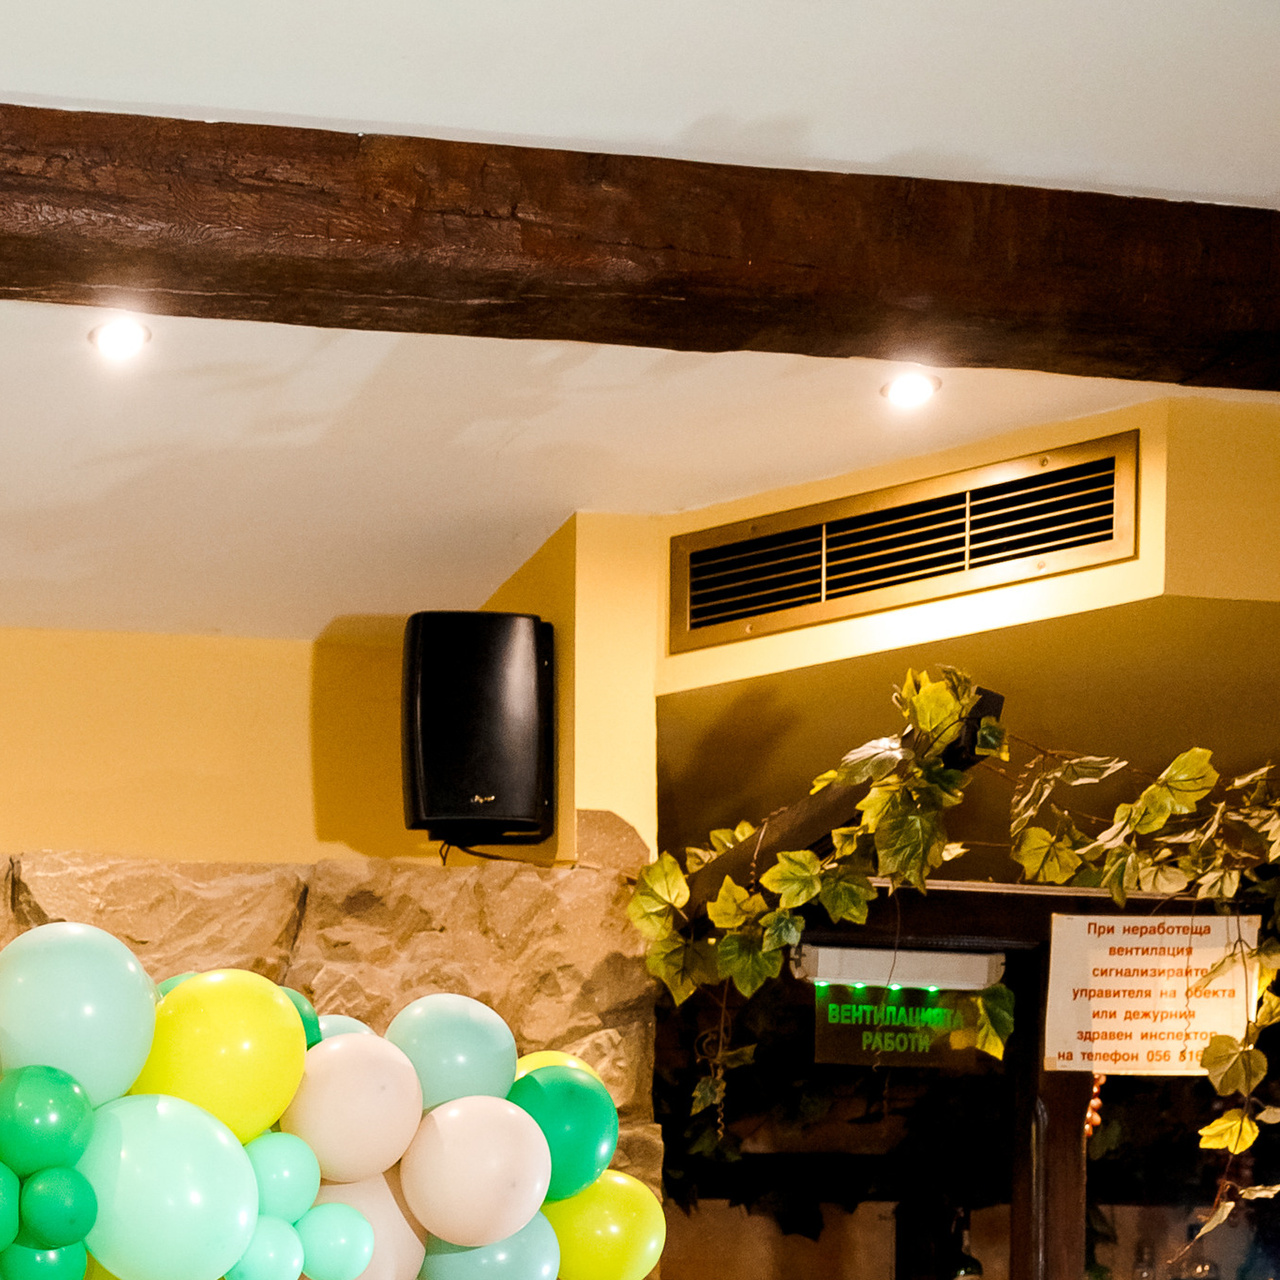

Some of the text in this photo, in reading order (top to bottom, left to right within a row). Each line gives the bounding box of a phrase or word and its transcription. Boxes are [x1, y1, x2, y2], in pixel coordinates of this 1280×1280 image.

[1087, 921, 1211, 938] При неработеща
[1108, 945, 1193, 959] вентилация
[1091, 964, 1208, 981] сигнализирайте
[1072, 984, 1236, 1001] управителя на обекта
[827, 1003, 964, 1028] ВЕНТИЛАЦИЯТА
[1092, 1008, 1196, 1023] или дежурния
[862, 1031, 930, 1053] РАБОТИ
[1077, 1030, 1133, 1042] здравен
[1057, 1051, 1073, 1061] на
[1080, 1049, 1139, 1066] телефон
[1146, 1050, 1171, 1062] 056
